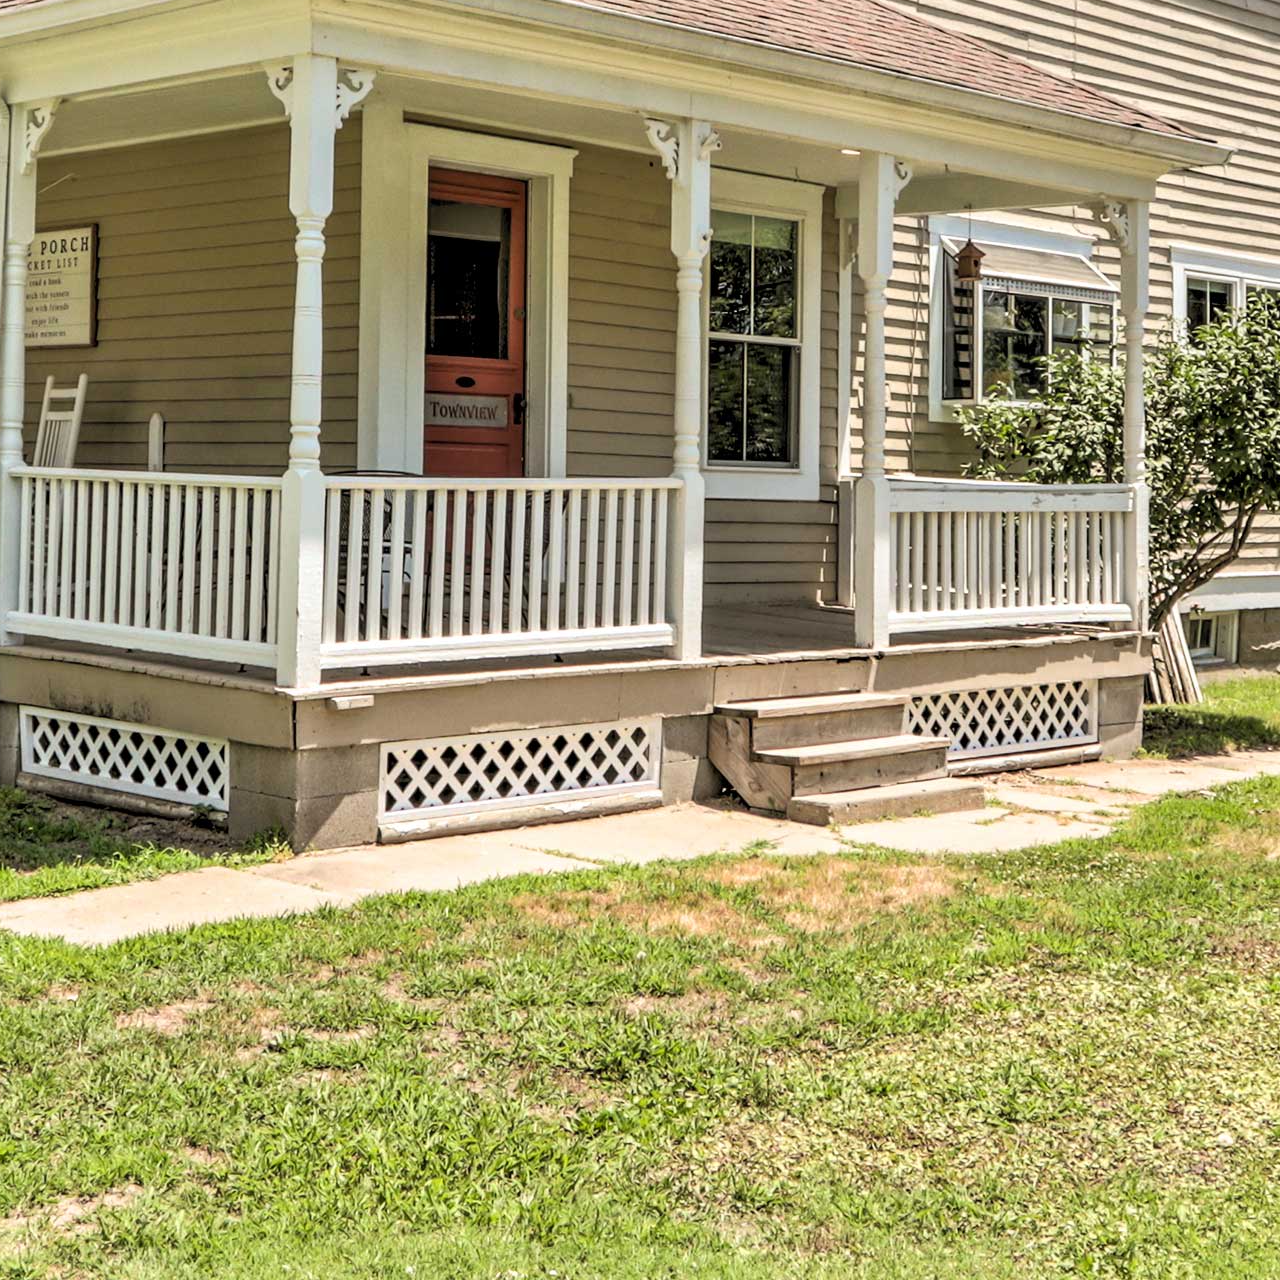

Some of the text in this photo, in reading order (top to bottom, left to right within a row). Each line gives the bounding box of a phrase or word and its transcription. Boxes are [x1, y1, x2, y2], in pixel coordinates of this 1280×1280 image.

[40, 237, 89, 255] PORCH
[26, 257, 78, 271] CKET LIST
[29, 278, 42, 287] read
[35, 303, 48, 312] with
[430, 401, 499, 421] TOWNVIEW
